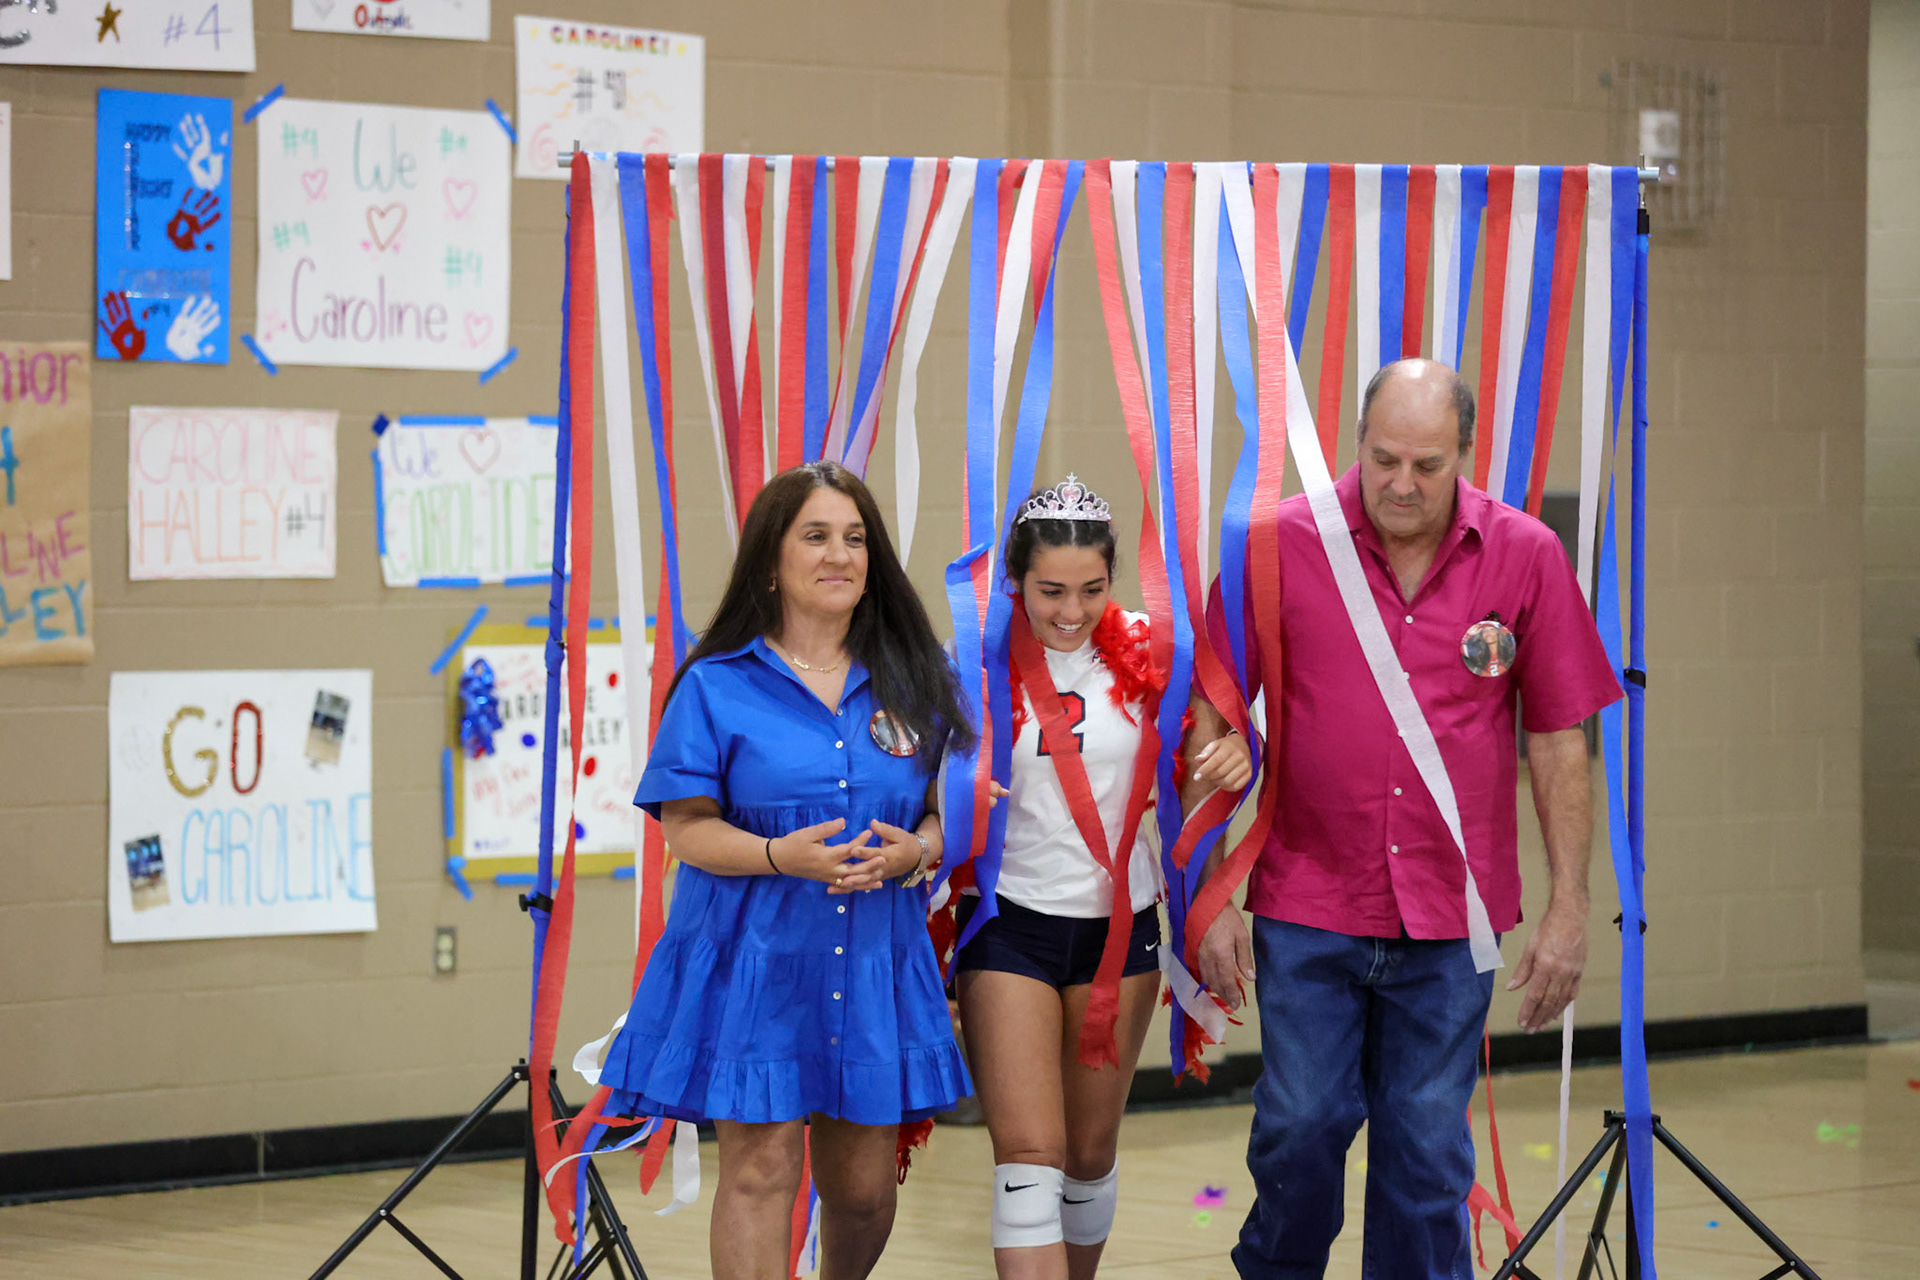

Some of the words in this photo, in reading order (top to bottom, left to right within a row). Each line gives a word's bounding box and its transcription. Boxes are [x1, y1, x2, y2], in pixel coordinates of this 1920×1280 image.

[164, 3, 232, 50] #4
[353, 118, 417, 192] We
[291, 257, 449, 343] Caroline
[443, 247, 483, 289] #4
[135, 415, 325, 485] CAROLINE
[388, 428, 442, 478] We
[138, 488, 285, 566] HALLEY
[162, 700, 263, 798] GO
[181, 793, 374, 905] CAROLINE
